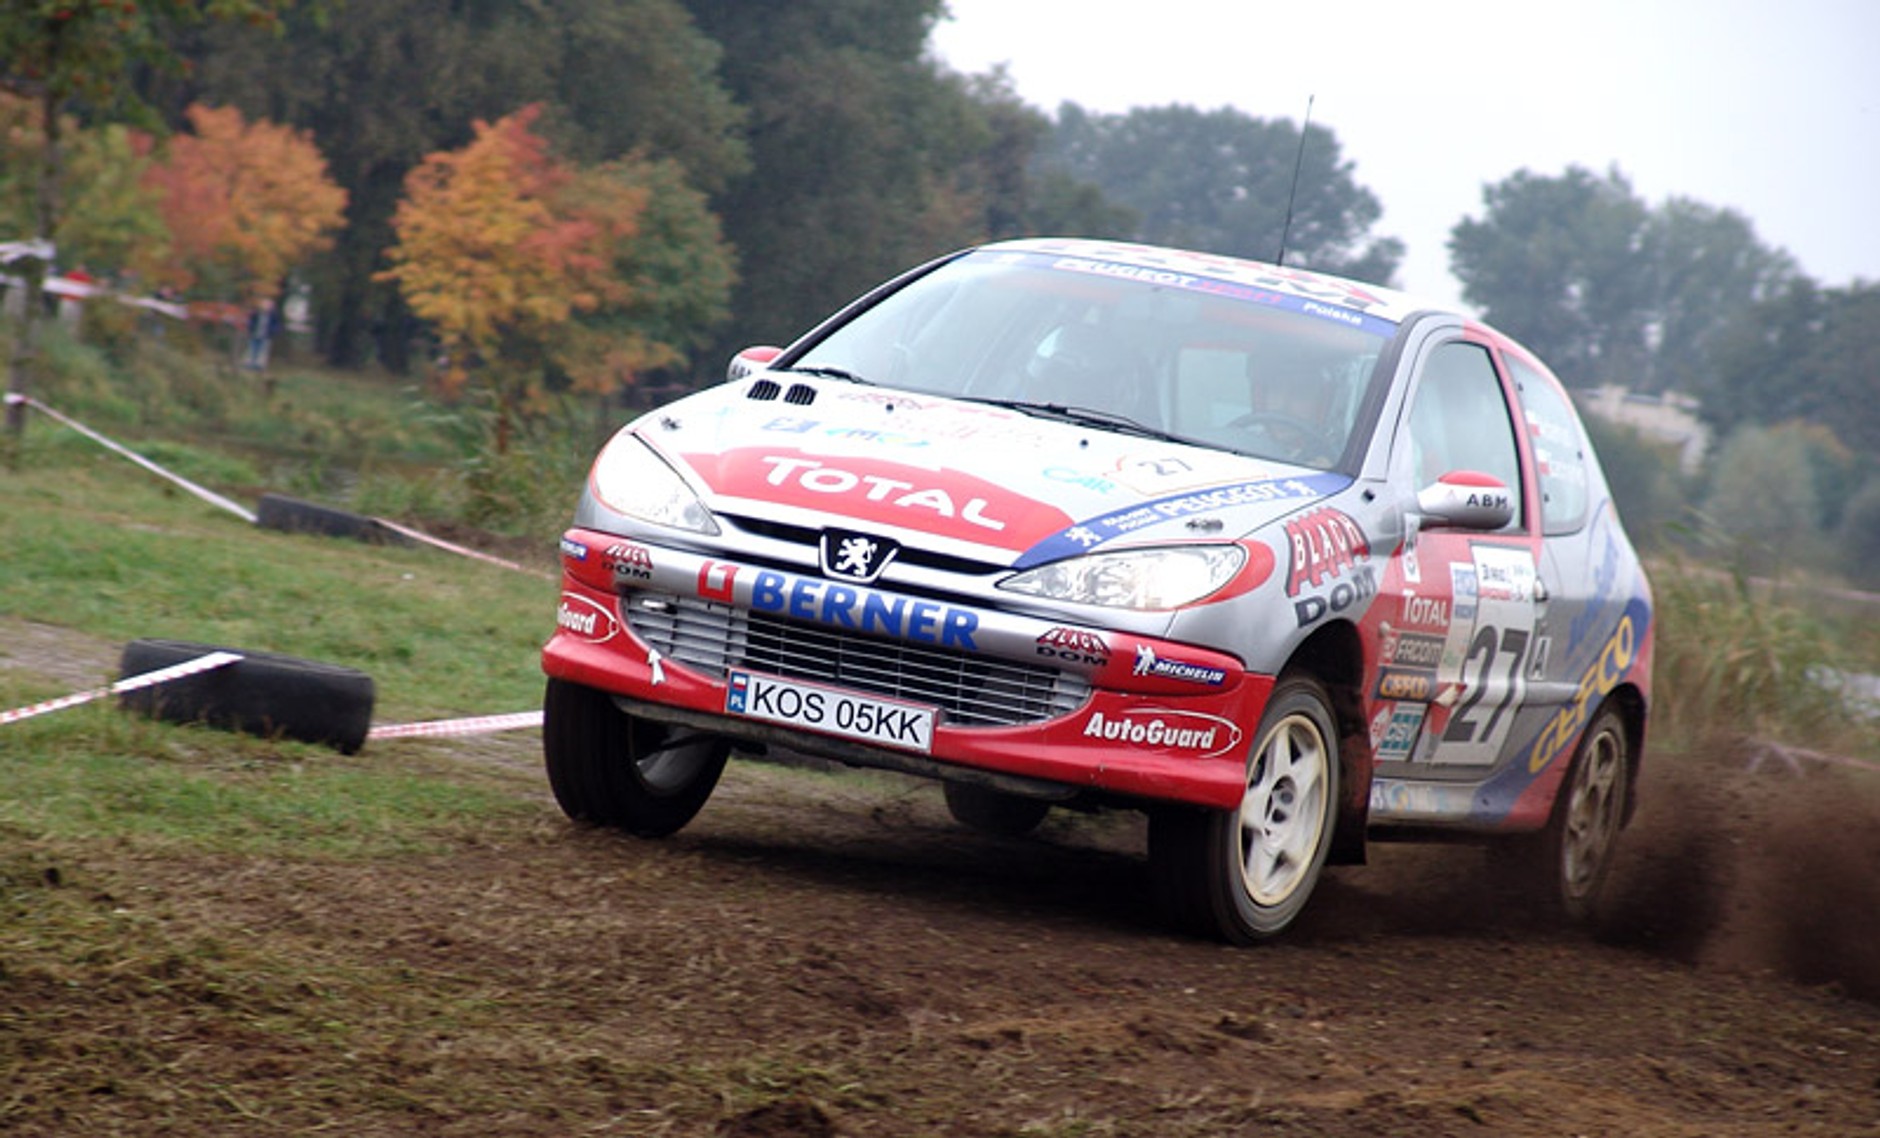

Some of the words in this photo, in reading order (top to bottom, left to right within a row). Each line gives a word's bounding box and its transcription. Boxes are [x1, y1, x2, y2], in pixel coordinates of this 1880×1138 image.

[1053, 259, 1197, 288] PEUGEOT
[1138, 456, 1194, 477] 27
[763, 456, 1006, 531] TOTAL
[1153, 483, 1287, 516] PEUGEOT
[752, 570, 979, 650] BERNER
[1294, 567, 1377, 628] DOM
[1403, 588, 1449, 625] TOTAL
[1036, 645, 1109, 668] DOM
[1153, 660, 1225, 685] MICHELIN
[731, 694, 744, 710] PL
[1442, 625, 1530, 743] 27
[1529, 615, 1634, 774] GEFCO
[753, 681, 825, 723] KOS
[836, 700, 923, 744] 05KK
[1084, 712, 1217, 749] AutoGuard
